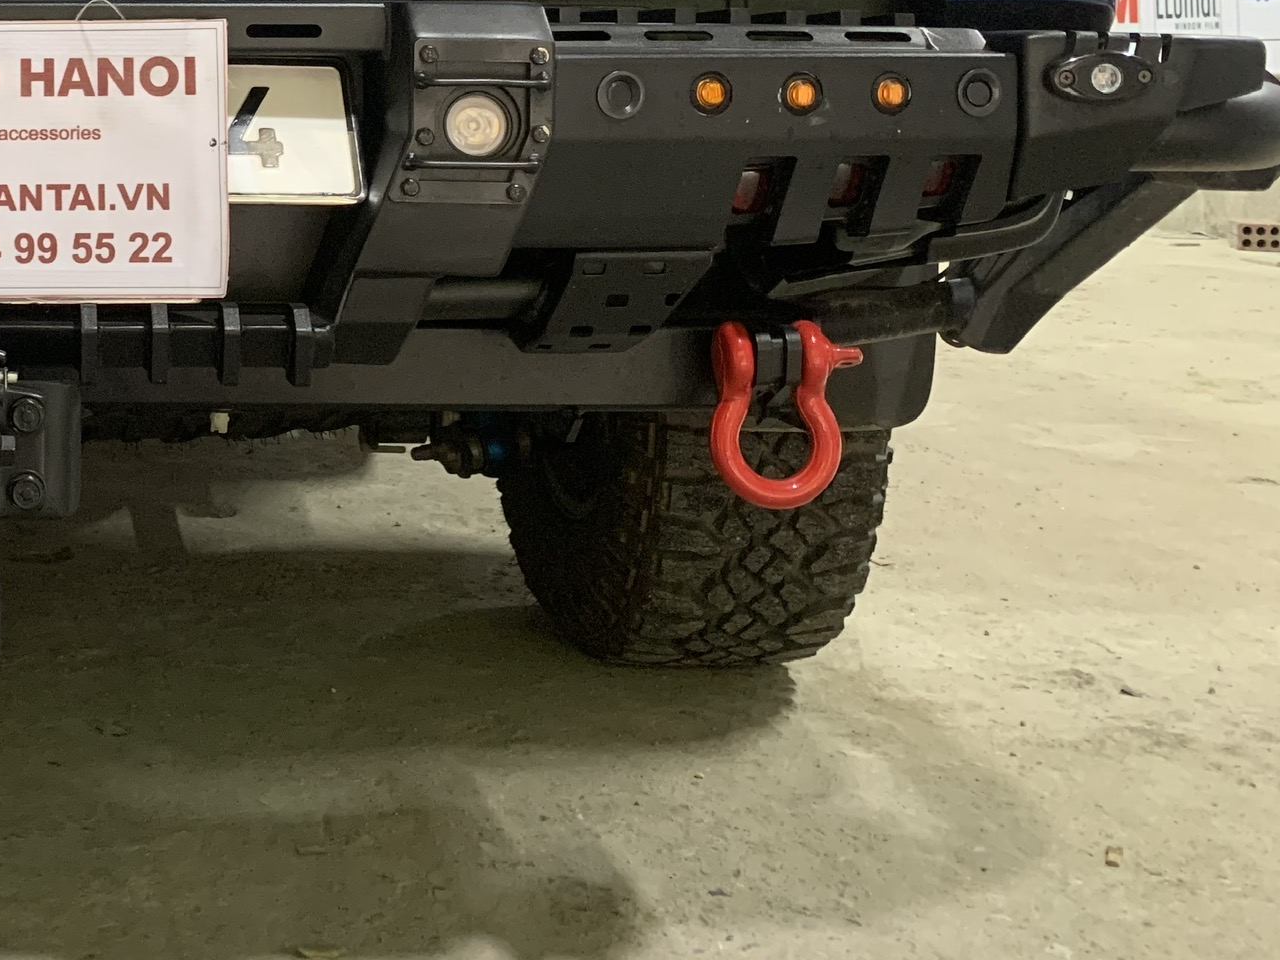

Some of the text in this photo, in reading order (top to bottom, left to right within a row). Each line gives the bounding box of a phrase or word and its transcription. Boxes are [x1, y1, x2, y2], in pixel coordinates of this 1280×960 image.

[1175, 22, 1201, 30] WINDOW
[19, 56, 197, 97] HANOI
[13, 232, 59, 265] 99
[71, 232, 116, 265] 55
[127, 231, 174, 264] 22
